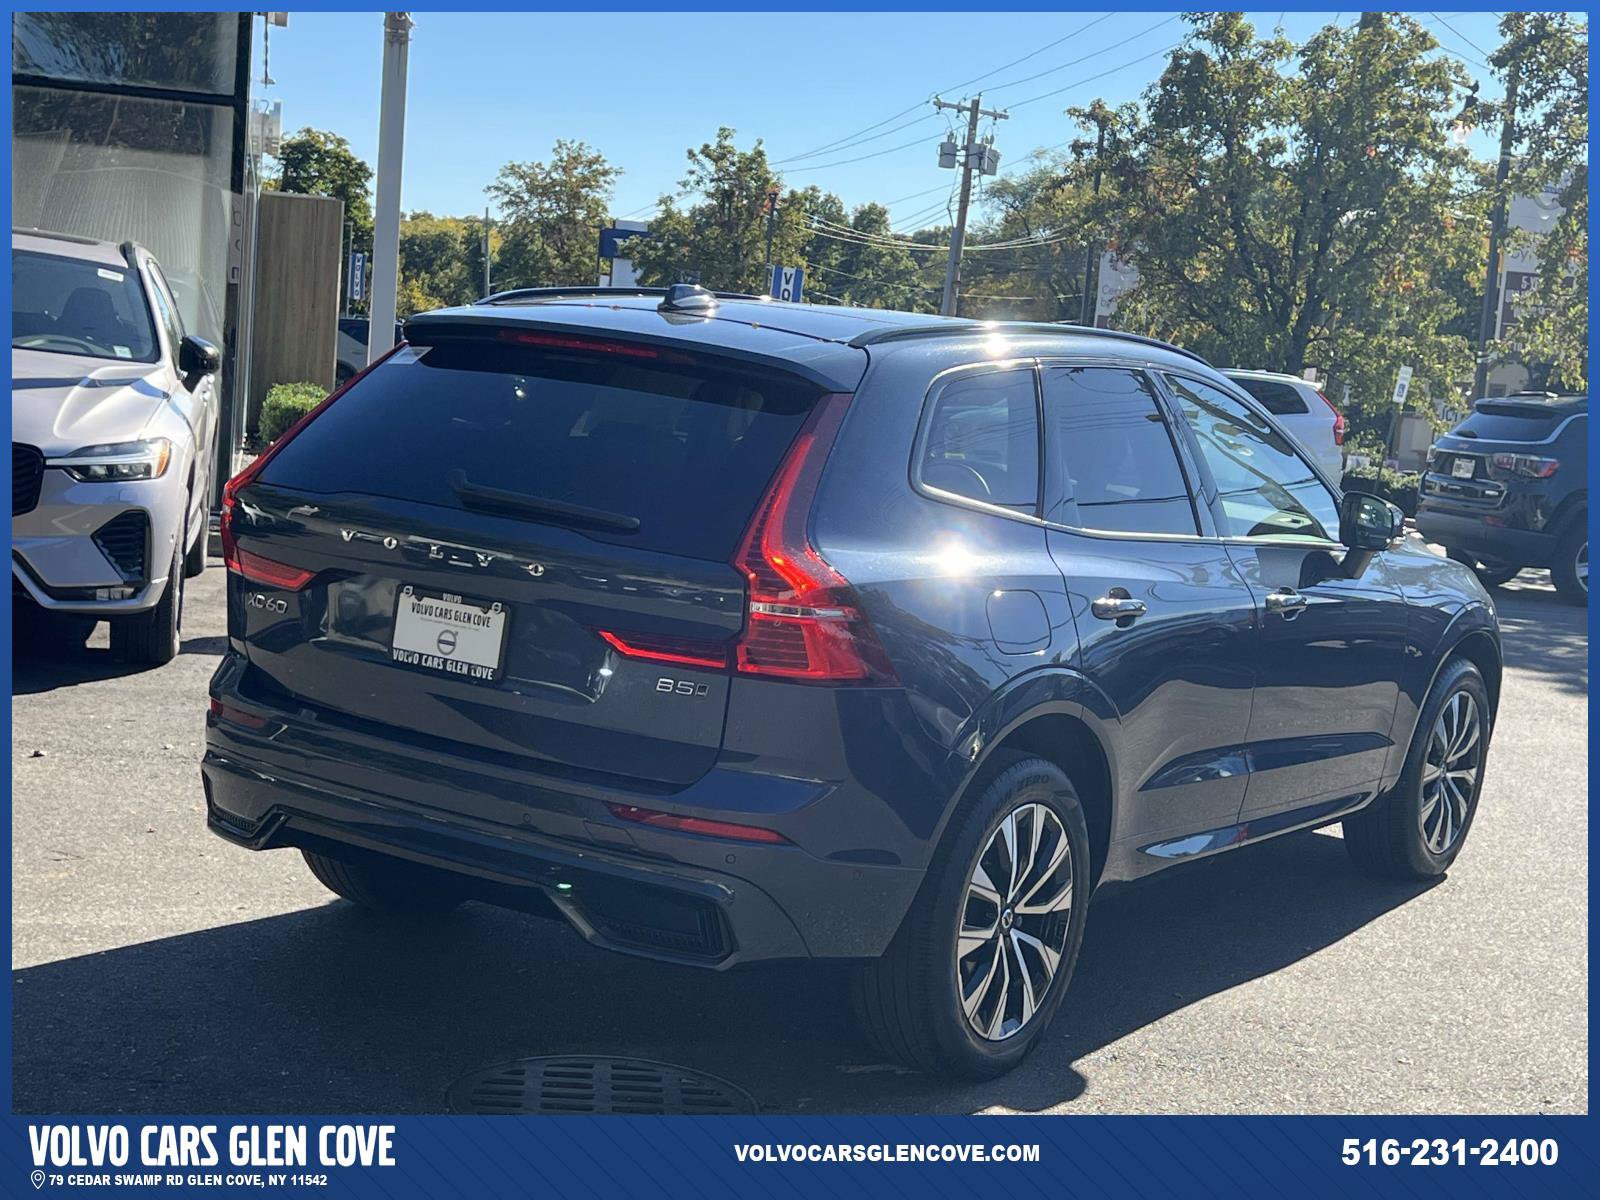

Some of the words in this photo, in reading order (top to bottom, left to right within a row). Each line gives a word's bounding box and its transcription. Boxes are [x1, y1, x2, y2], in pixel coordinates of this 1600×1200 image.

[354, 256, 362, 297] VOLVO
[339, 527, 546, 577] VOLVO
[247, 591, 288, 614] XC60
[442, 592, 462, 604] VOLVO
[411, 601, 433, 617] VOLVO
[434, 607, 453, 621] CARS
[453, 610, 472, 625] GLEN
[472, 614, 492, 628] COVE
[392, 648, 419, 665] VOLVO
[421, 655, 444, 670] CARS
[446, 659, 468, 676] GLEN
[470, 665, 494, 681] COVE
